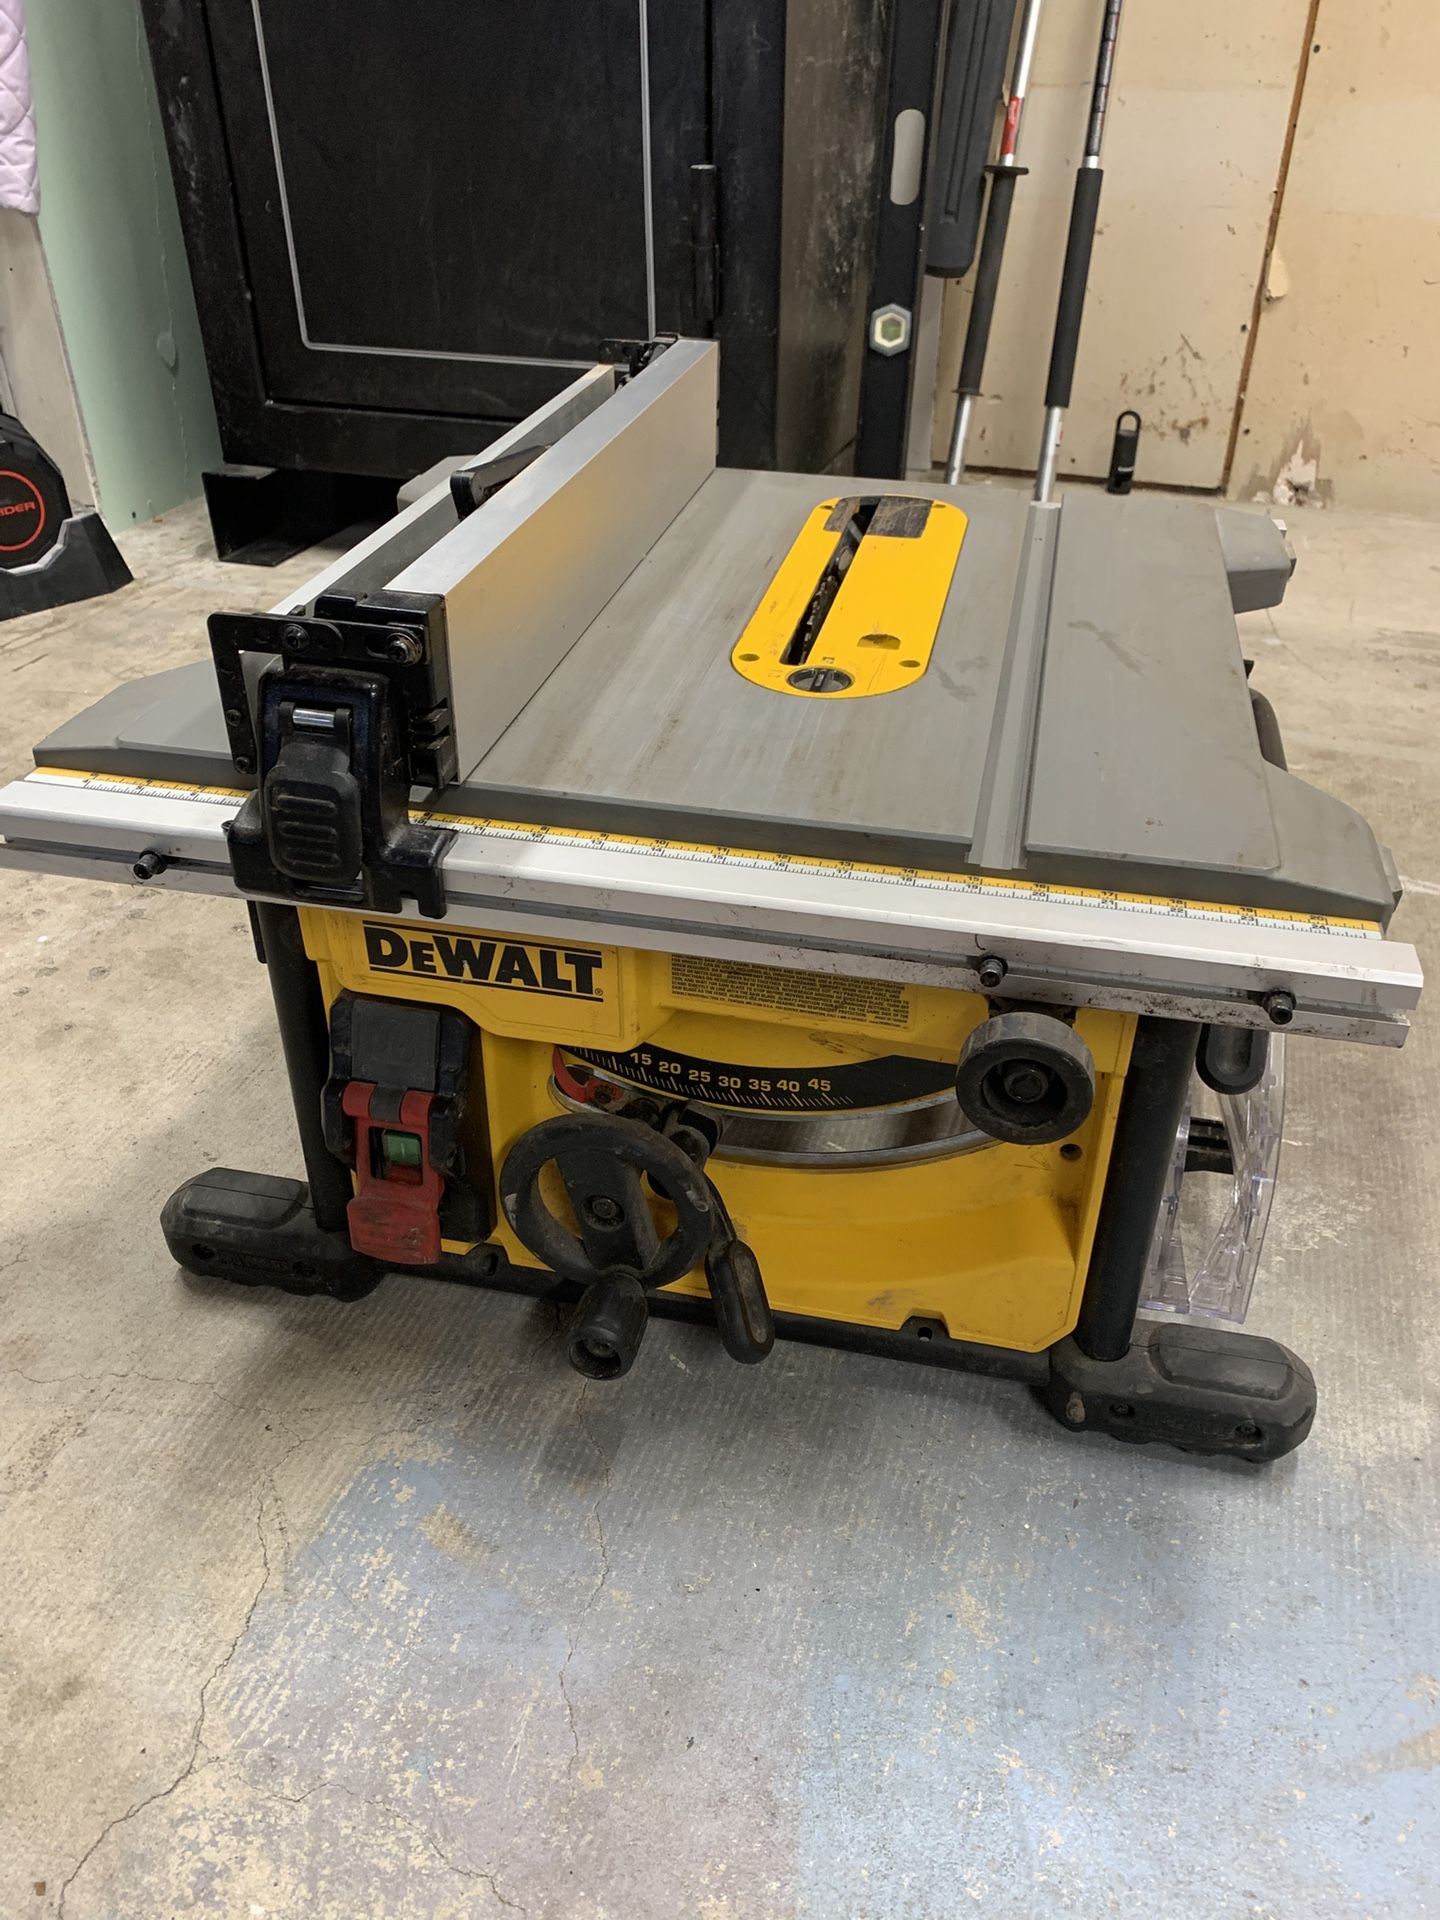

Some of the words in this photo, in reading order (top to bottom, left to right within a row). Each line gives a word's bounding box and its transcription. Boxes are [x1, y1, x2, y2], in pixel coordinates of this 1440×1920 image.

[630, 1052, 652, 1065] 15
[658, 1061, 681, 1075] 20
[688, 1069, 711, 1083] 25
[718, 1075, 741, 1089] 30
[748, 1078, 771, 1092] 35
[777, 1079, 800, 1093] 40
[807, 1078, 831, 1091] 45
